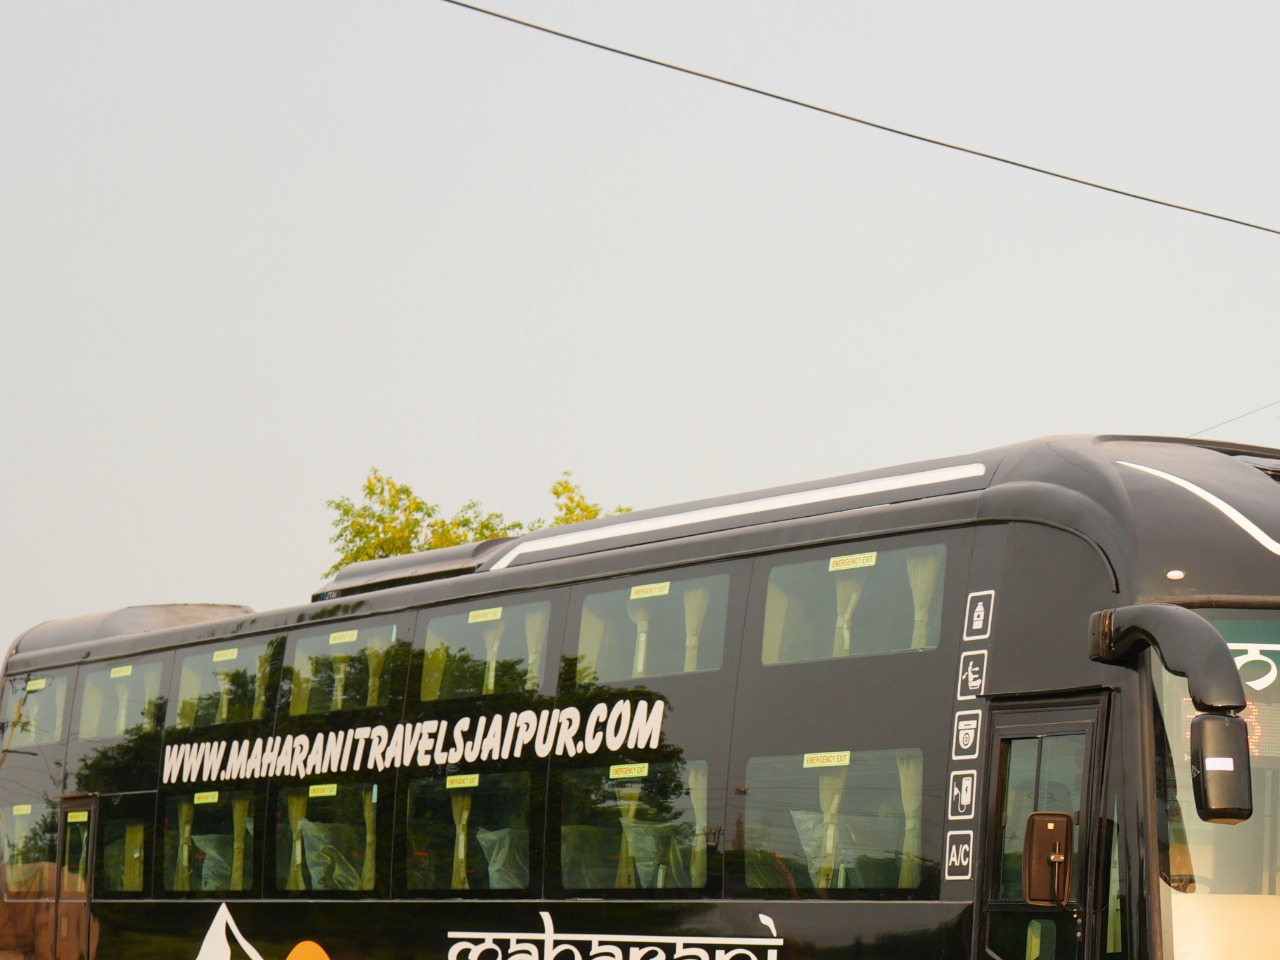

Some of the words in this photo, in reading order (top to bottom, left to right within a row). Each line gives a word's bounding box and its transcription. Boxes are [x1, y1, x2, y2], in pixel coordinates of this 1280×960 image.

[162, 700, 666, 785] WWW.MAHARANITRAVELSJAIPUR.COM
[806, 755, 836, 765] EMERGENCY
[948, 842, 970, 867] A/C
